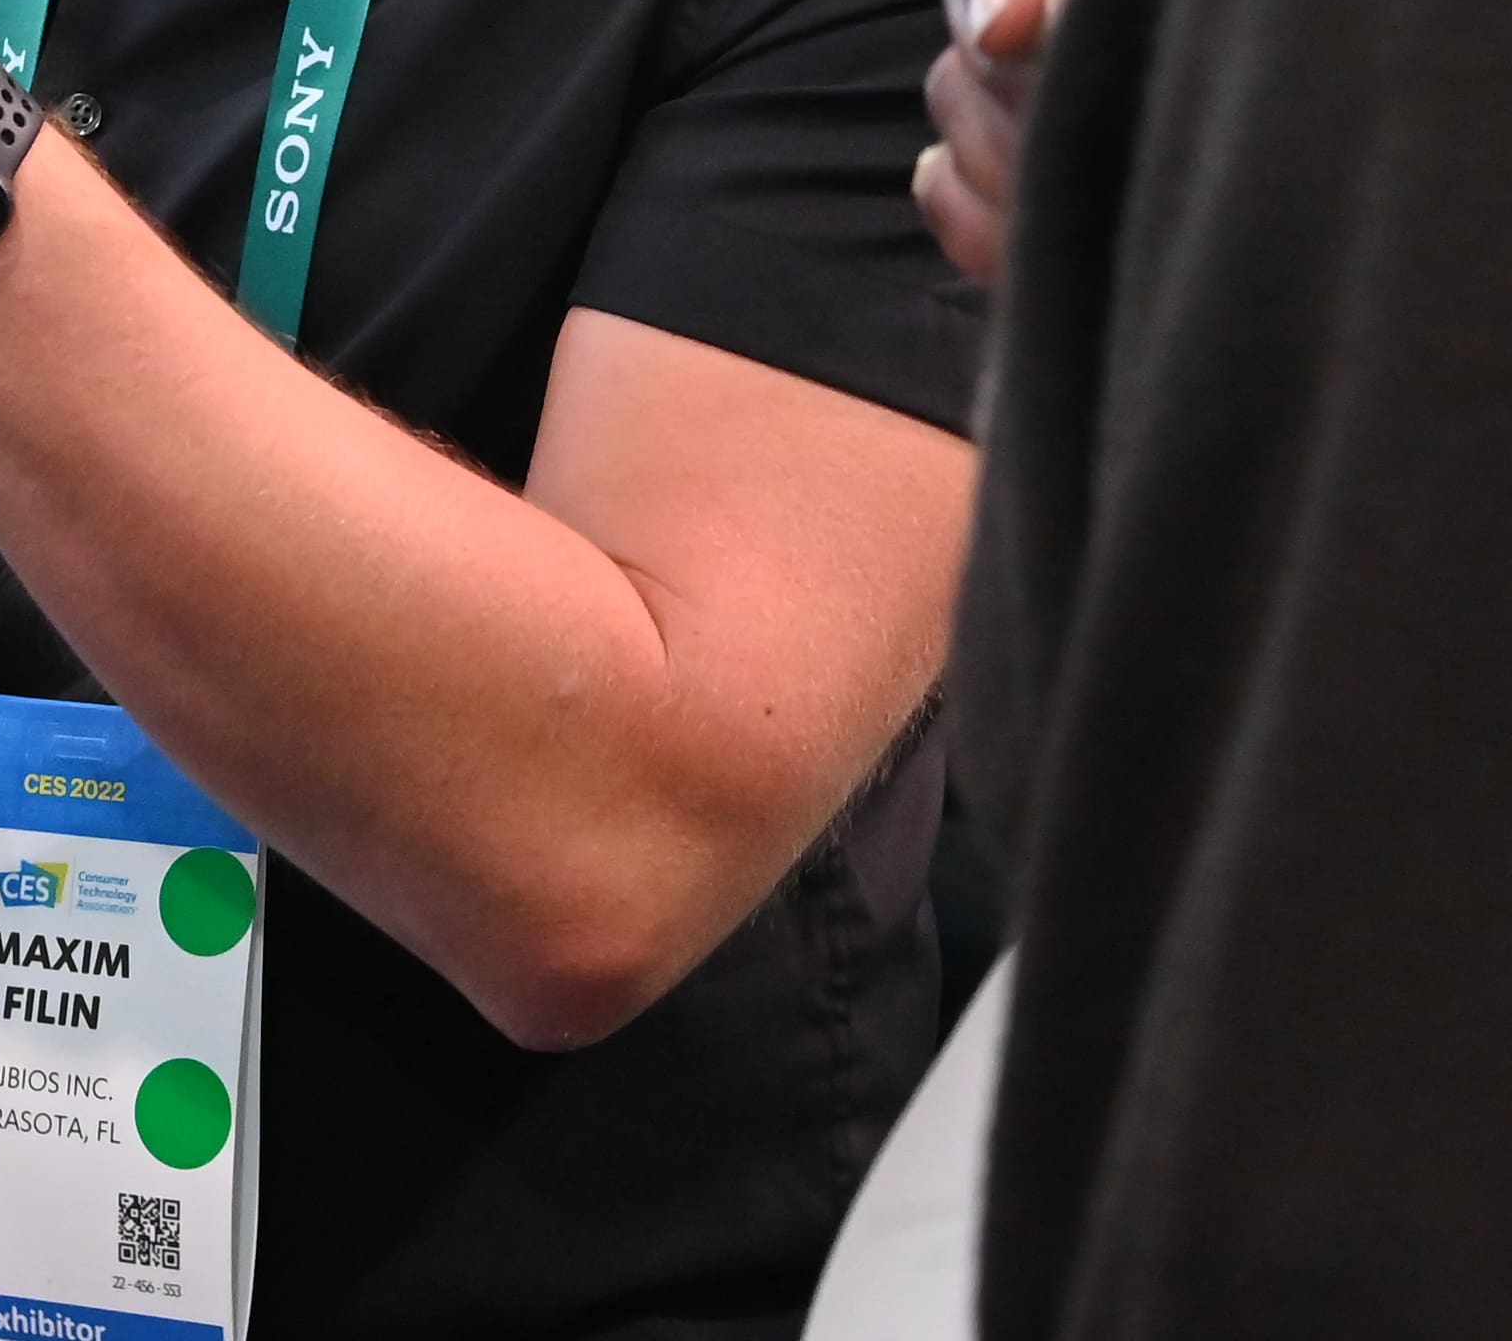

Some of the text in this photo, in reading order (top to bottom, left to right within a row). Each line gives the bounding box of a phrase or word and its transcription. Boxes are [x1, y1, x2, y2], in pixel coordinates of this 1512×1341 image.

[264, 26, 335, 235] SONY
[23, 773, 126, 802] CES 2022
[1, 873, 50, 902] CES
[77, 870, 129, 886] Consumer
[76, 899, 136, 916] Association
[77, 884, 137, 904] Technology
[2, 985, 101, 1030] FILIN
[66, 1073, 114, 1102] INC.
[97, 1120, 121, 1145] FL
